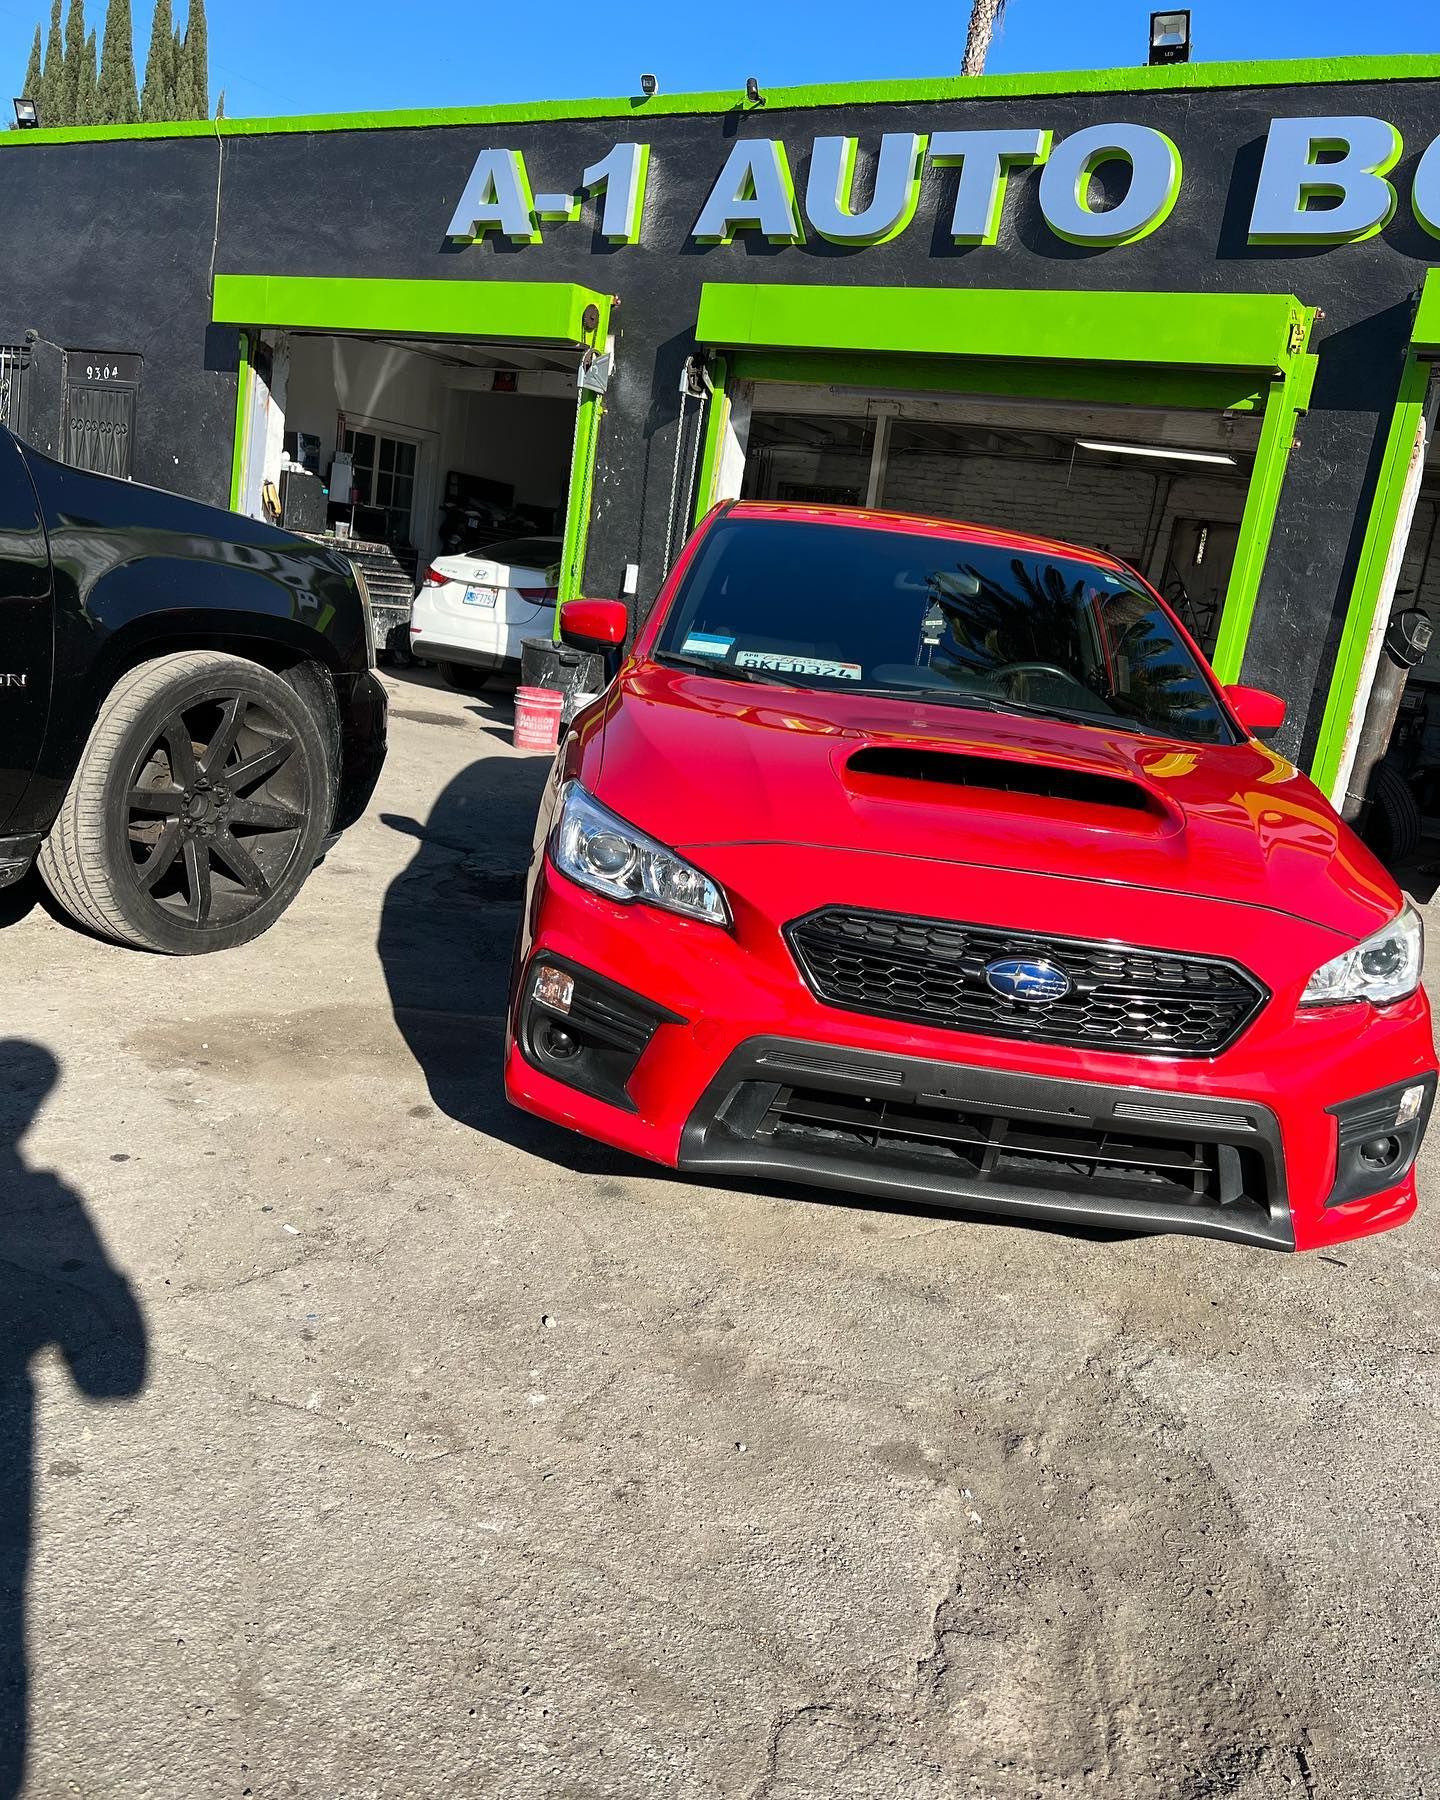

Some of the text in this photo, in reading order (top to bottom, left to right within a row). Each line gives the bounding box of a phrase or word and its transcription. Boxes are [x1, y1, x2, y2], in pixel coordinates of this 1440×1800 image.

[446, 116, 1440, 246] A-1 AUTO B
[86, 365, 119, 380] 9304
